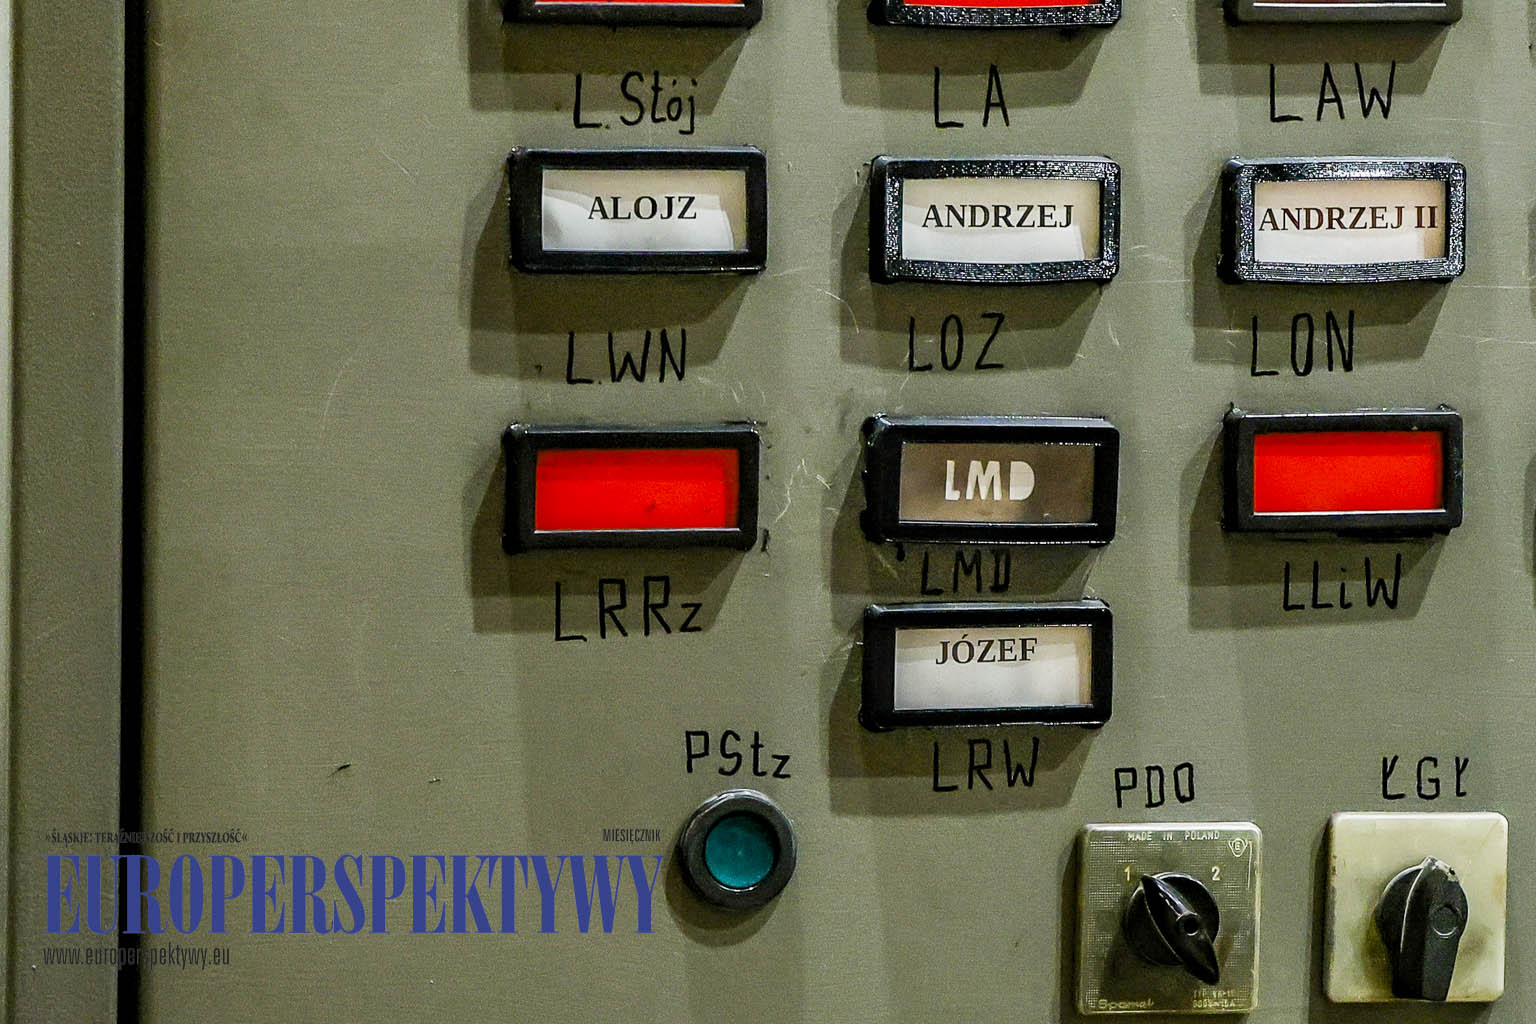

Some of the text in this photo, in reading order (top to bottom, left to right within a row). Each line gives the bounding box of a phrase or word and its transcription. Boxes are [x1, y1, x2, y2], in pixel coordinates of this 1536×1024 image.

[1269, 60, 1395, 122] LAW
[587, 195, 698, 221] ALOJZ
[921, 203, 1074, 229] ANDRZEJ
[1258, 205, 1438, 232] ANDRZEJ II
[908, 312, 1005, 371] LOZ
[1251, 310, 1355, 376] LON
[945, 460, 1035, 502] LMD
[1283, 554, 1400, 611] LLiW
[554, 576, 703, 642] LRRz
[936, 634, 1038, 665] JÓZEF
[685, 730, 791, 779] PStz
[932, 737, 1040, 792] LRW
[1127, 830, 1220, 841] MADE IN POLAND
[1124, 865, 1131, 882] 1
[1211, 865, 1221, 881] 2
